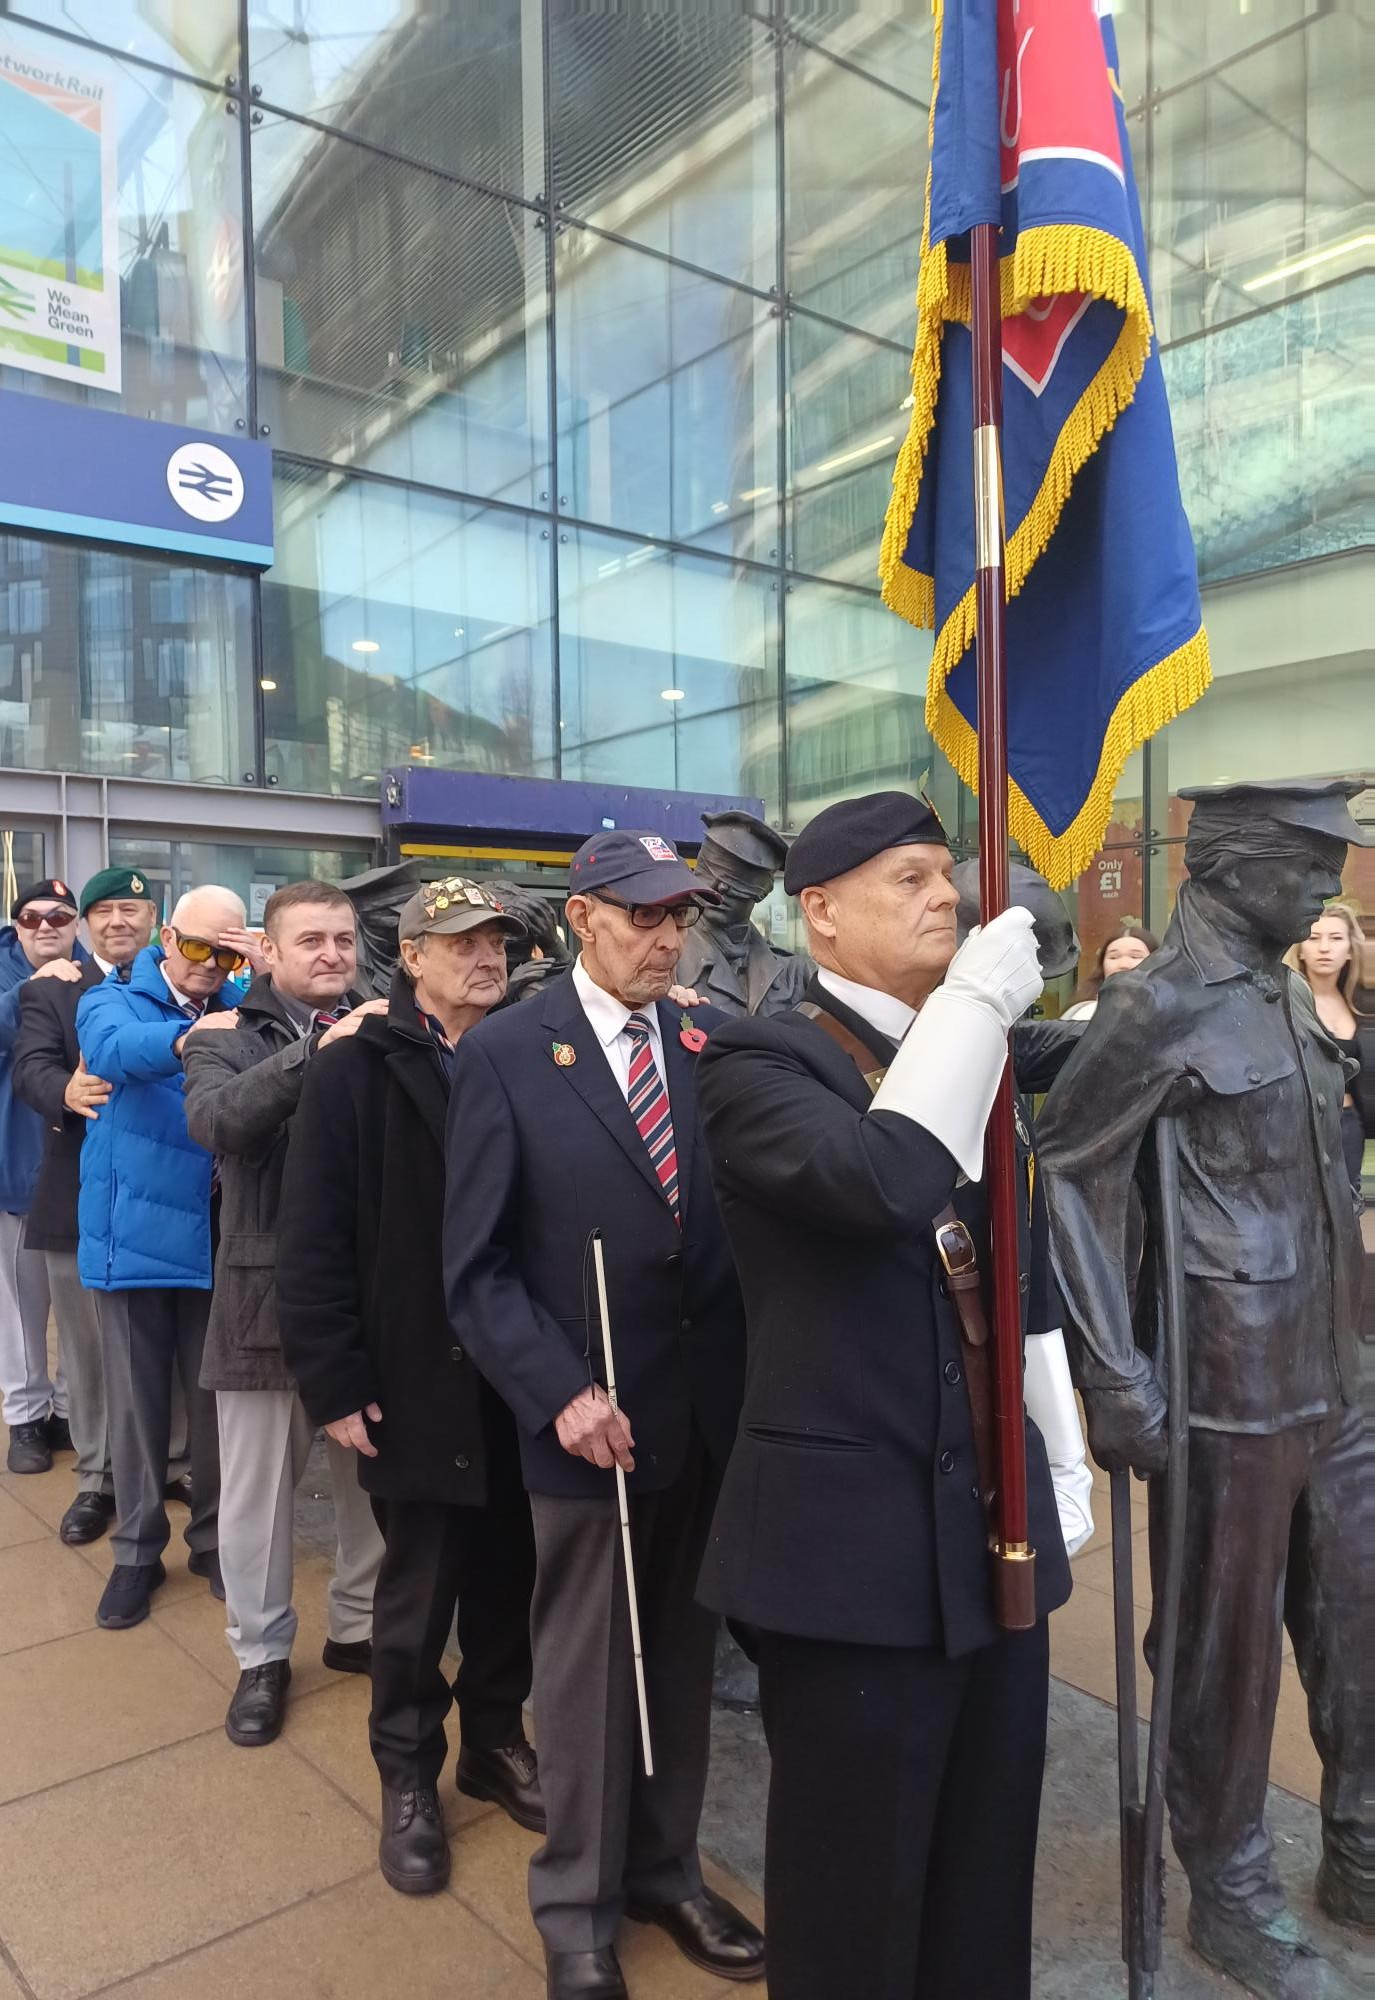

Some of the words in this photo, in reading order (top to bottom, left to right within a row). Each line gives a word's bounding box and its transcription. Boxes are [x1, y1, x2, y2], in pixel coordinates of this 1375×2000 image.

[47, 287, 71, 306] We
[48, 302, 89, 324] Mean
[48, 316, 94, 339] Green
[1098, 859, 1123, 871] Only
[1100, 871, 1121, 890] £1
[1102, 891, 1119, 899] each
